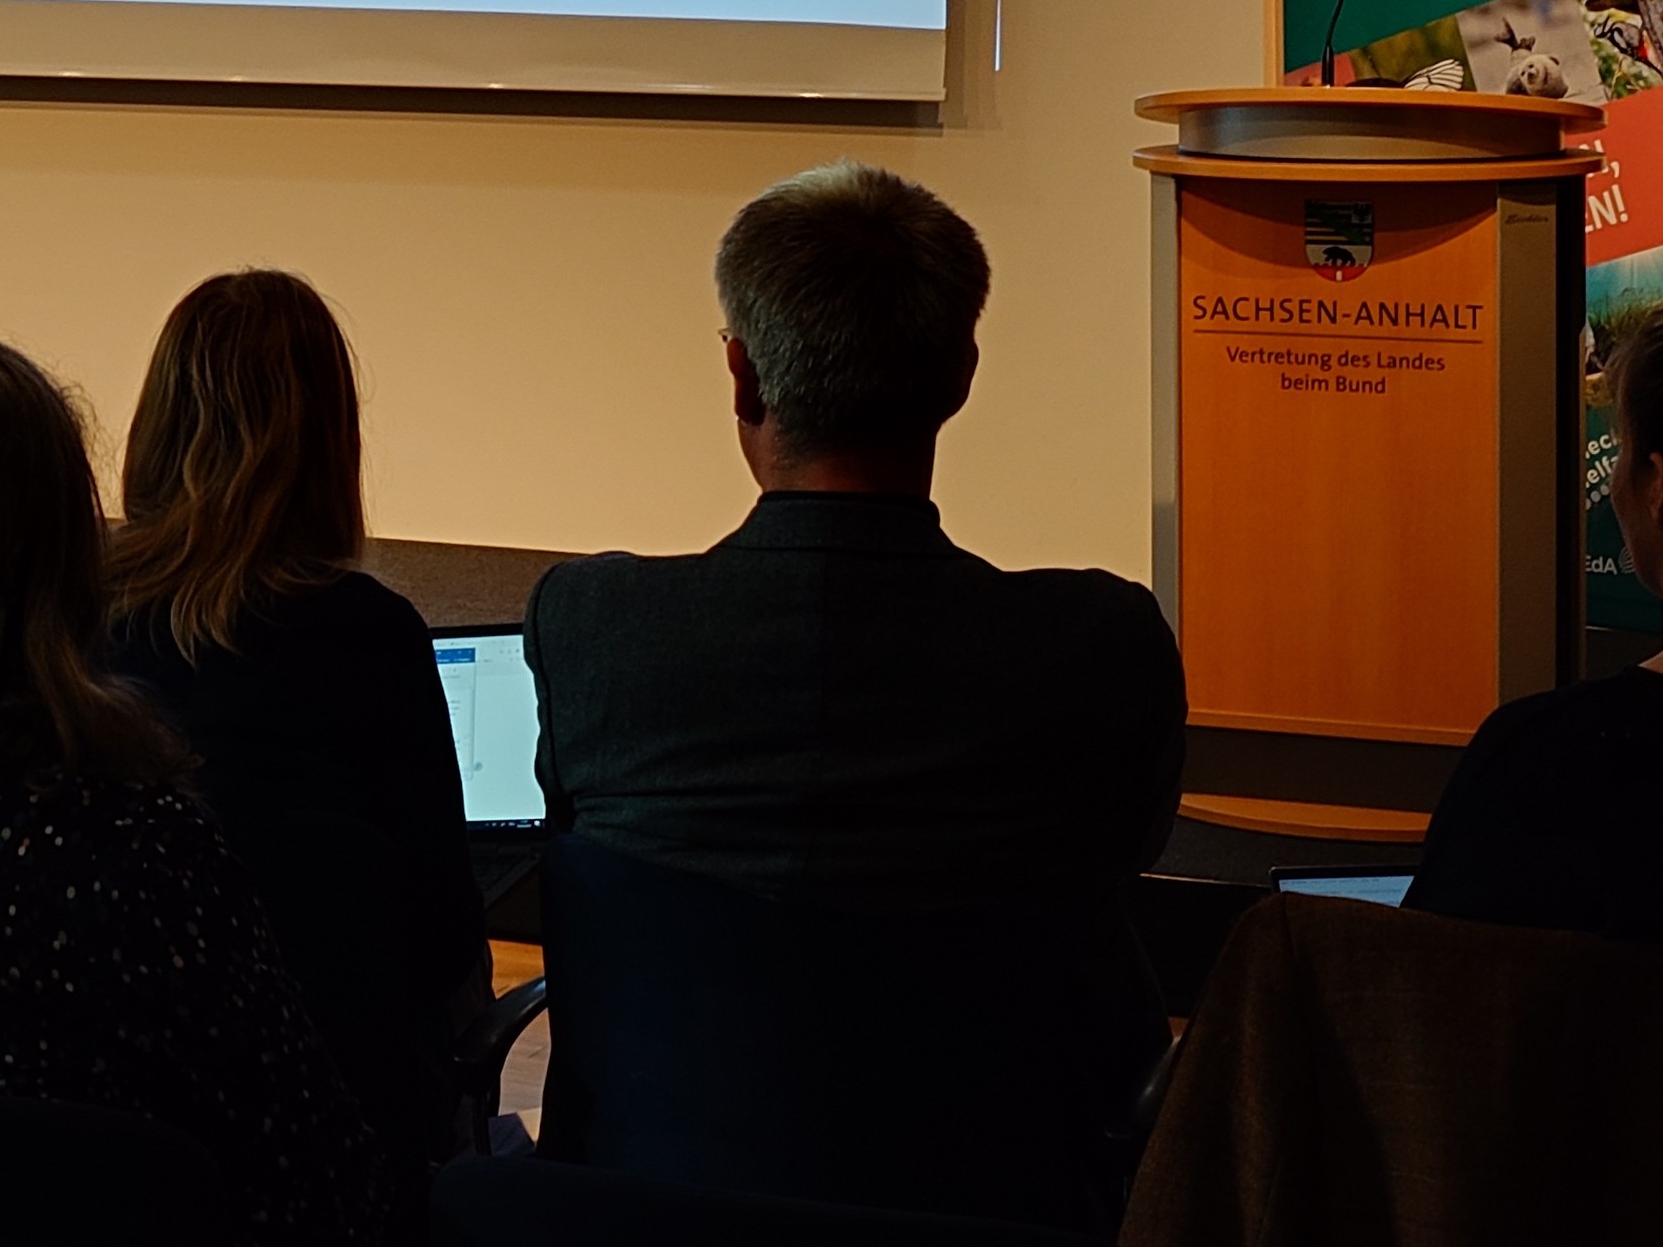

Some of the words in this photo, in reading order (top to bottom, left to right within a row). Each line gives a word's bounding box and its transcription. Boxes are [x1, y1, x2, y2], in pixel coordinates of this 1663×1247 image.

[1585, 183, 1628, 233] N!
[1192, 295, 1483, 331] SACHSEN-ANHALT
[1226, 345, 1332, 371] Vertretung
[1337, 349, 1371, 369] des
[1376, 349, 1446, 372] Landes
[1280, 372, 1329, 392] beim
[1336, 375, 1386, 394] Bund
